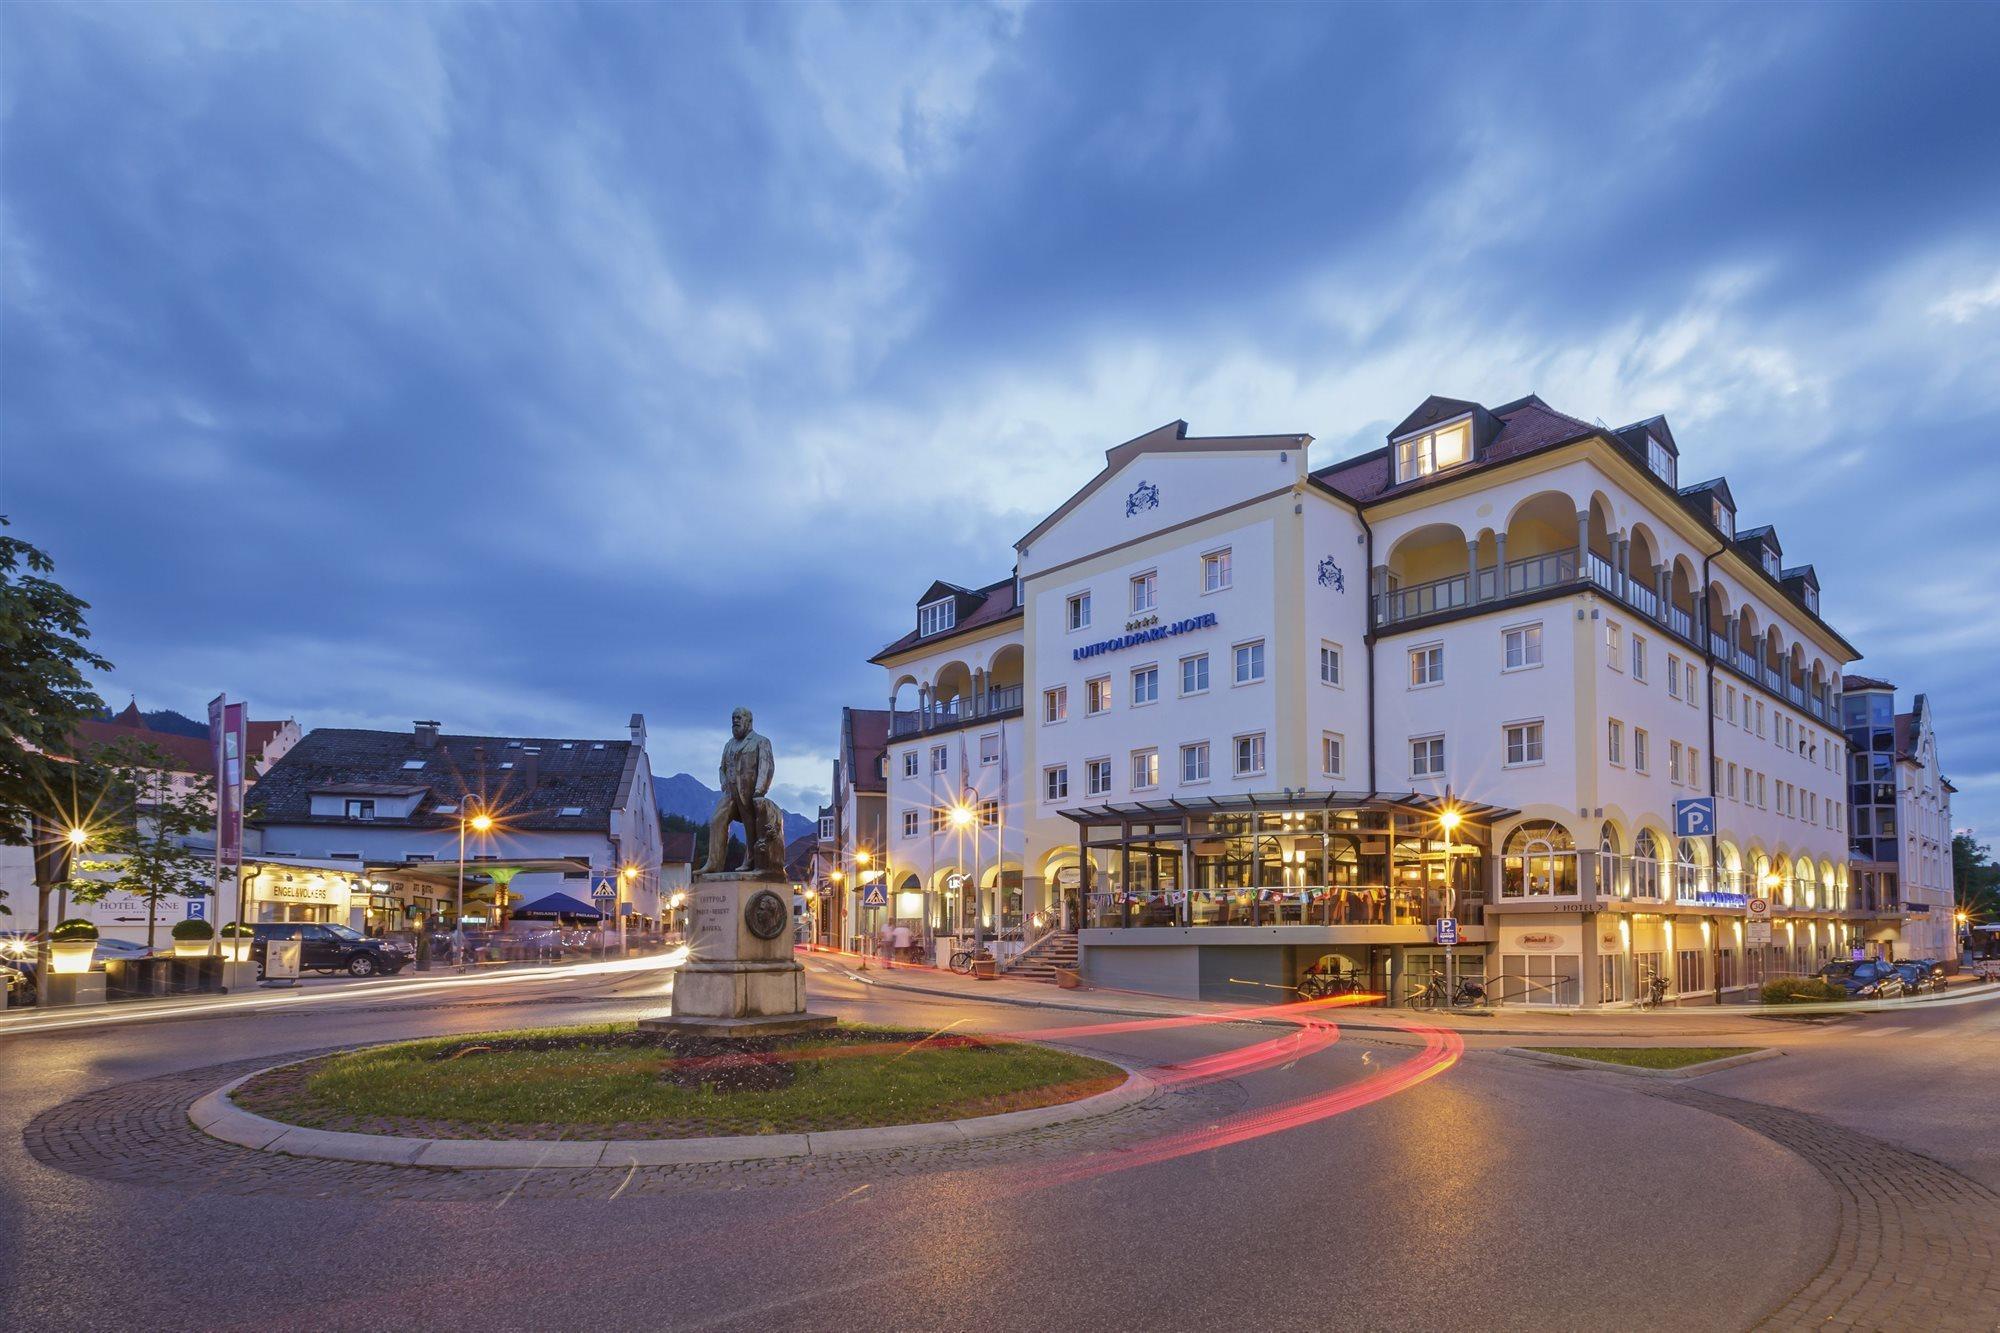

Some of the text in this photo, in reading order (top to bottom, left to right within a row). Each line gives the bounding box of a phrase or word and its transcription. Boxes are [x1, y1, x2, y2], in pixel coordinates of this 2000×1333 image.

[1073, 612, 1218, 661] LUITPOLDPARK-HOTEL
[1688, 812, 1704, 833] P
[191, 903, 201, 914] P
[1563, 904, 1593, 912] HOTEL
[1441, 920, 1452, 932] P
